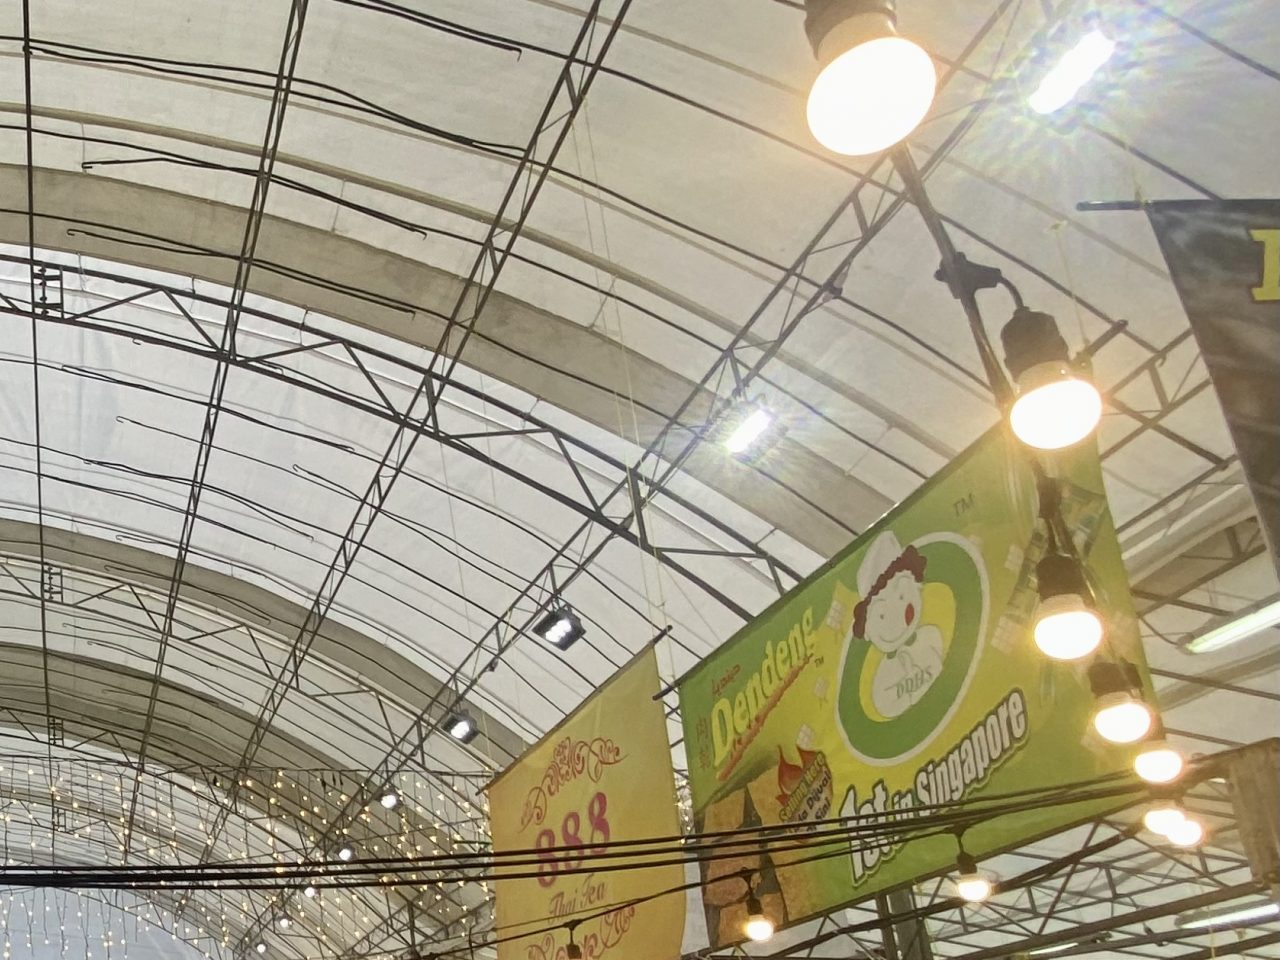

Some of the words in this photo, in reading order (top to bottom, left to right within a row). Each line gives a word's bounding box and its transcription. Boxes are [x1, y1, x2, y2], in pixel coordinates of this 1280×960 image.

[711, 606, 814, 768] Dendeng
[916, 691, 1026, 817] Singapore
[535, 792, 610, 888] 888
[548, 887, 577, 925] Thai
[580, 872, 608, 909] Tea
